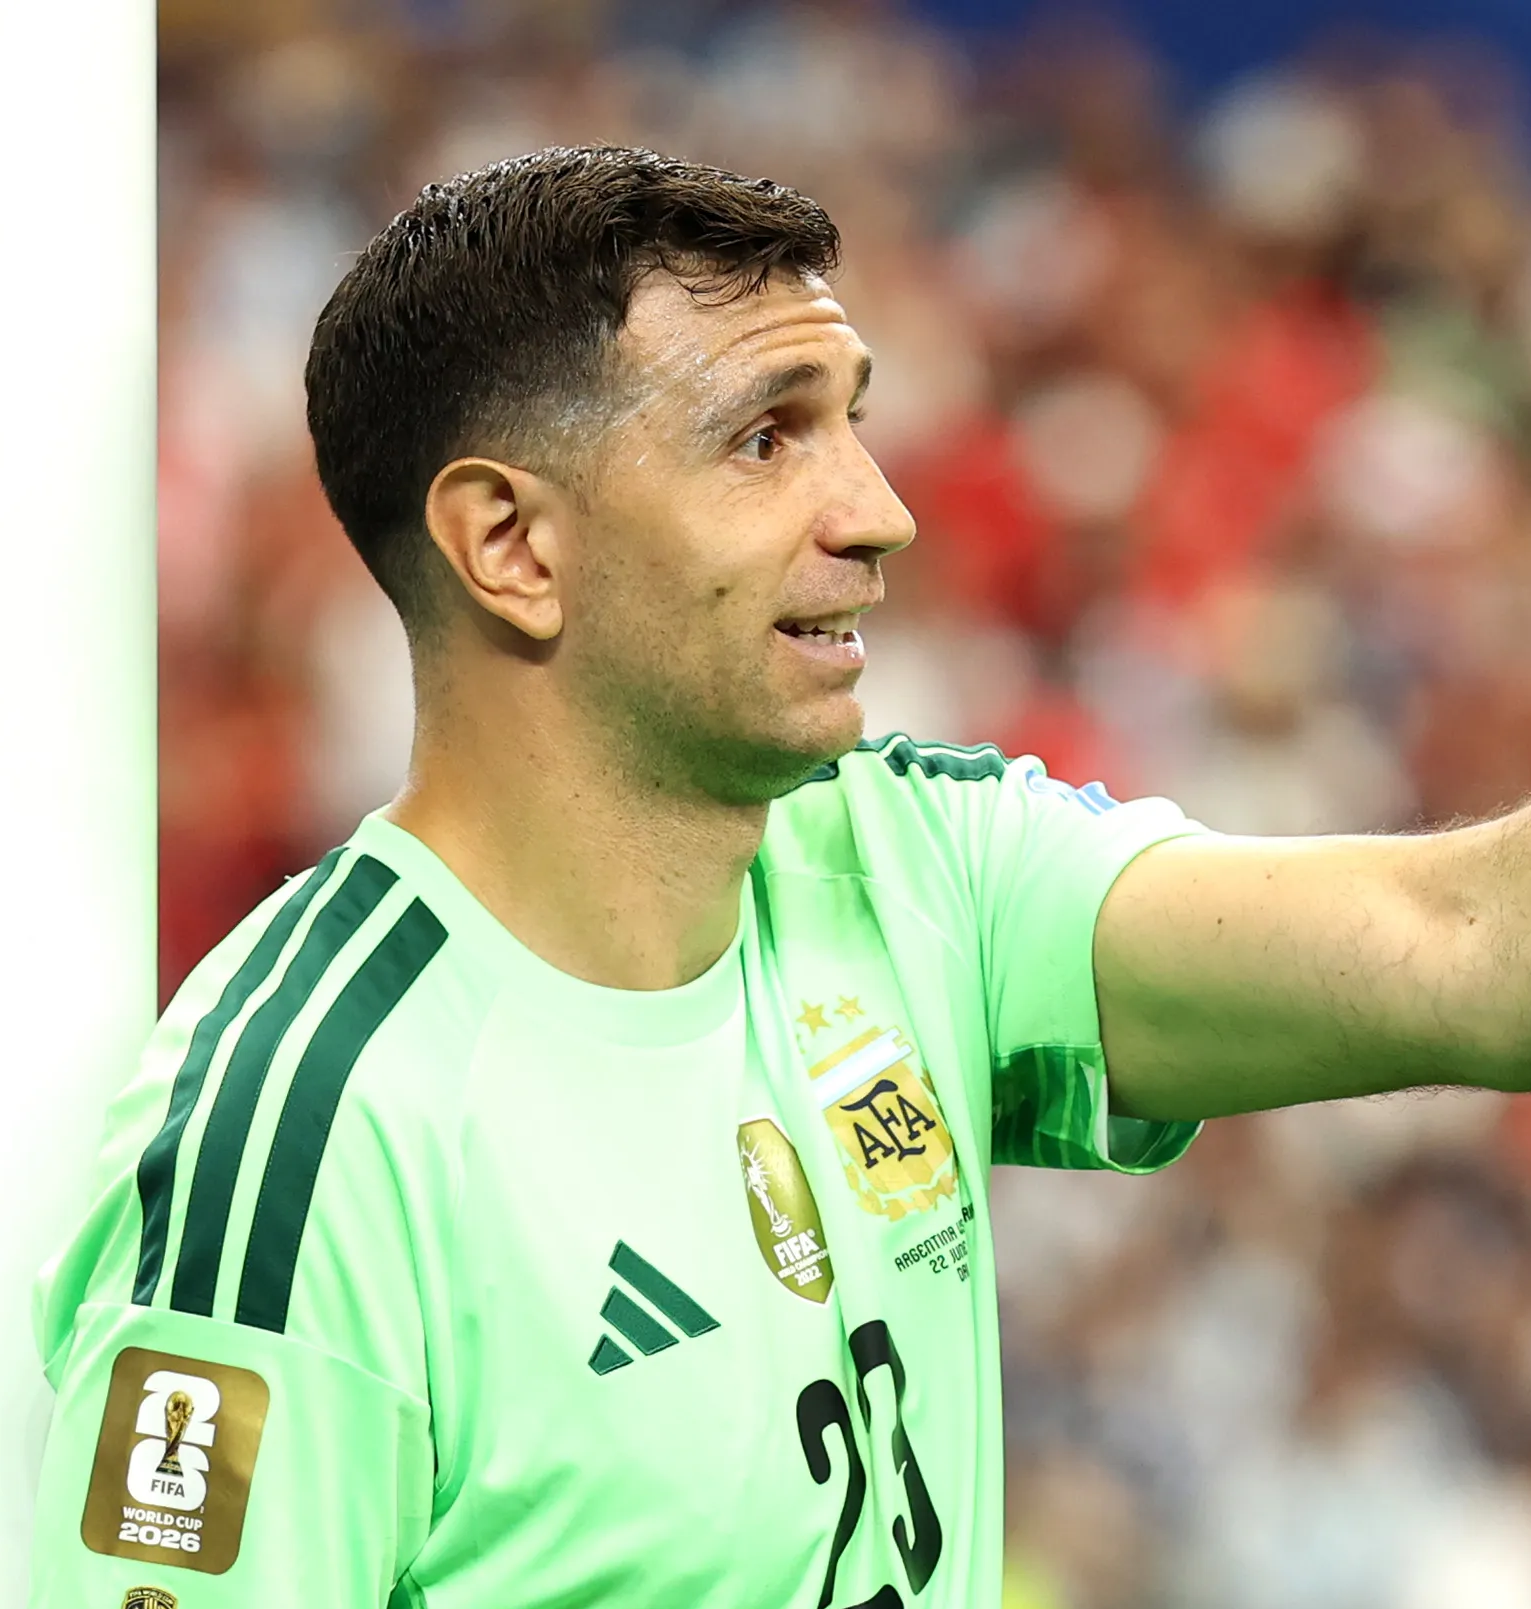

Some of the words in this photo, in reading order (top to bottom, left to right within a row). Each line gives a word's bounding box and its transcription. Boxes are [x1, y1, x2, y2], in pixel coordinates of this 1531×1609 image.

[839, 1079, 937, 1170] AFA
[894, 1226, 958, 1272] ARGENTINA
[929, 1255, 949, 1274] 22
[150, 1479, 185, 1498] FIFA
[123, 1506, 174, 1526] WORLD
[175, 1516, 203, 1531] CUP
[118, 1522, 201, 1553] 2026
